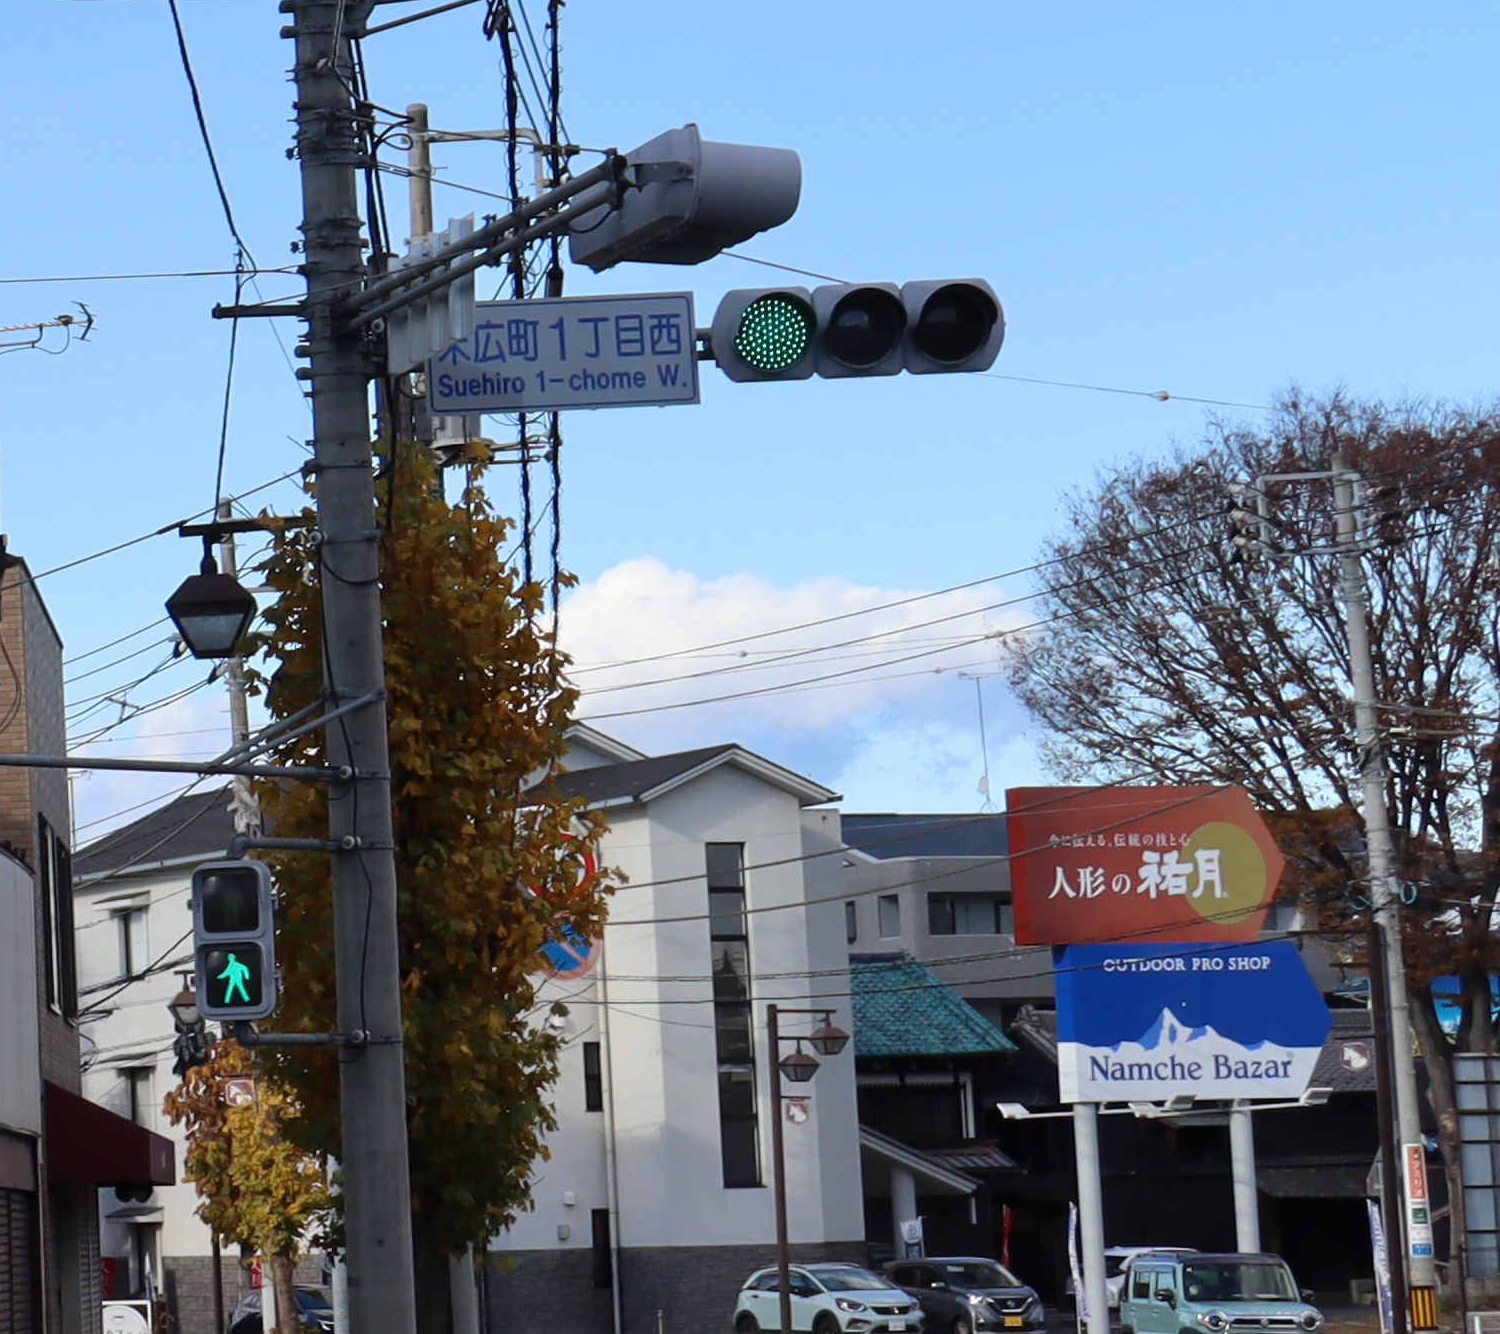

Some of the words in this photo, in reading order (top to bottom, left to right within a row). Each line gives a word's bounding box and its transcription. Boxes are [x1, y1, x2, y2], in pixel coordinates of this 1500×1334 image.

[438, 369, 525, 398] Suehiro
[536, 368, 646, 393] 1-chome
[657, 364, 687, 388] W.
[1103, 958, 1187, 973] OUTDOOR
[1192, 957, 1224, 972] PRO
[1228, 955, 1271, 971] SHOP
[1089, 1055, 1203, 1081] Namche
[1213, 1054, 1292, 1080] Bazar
